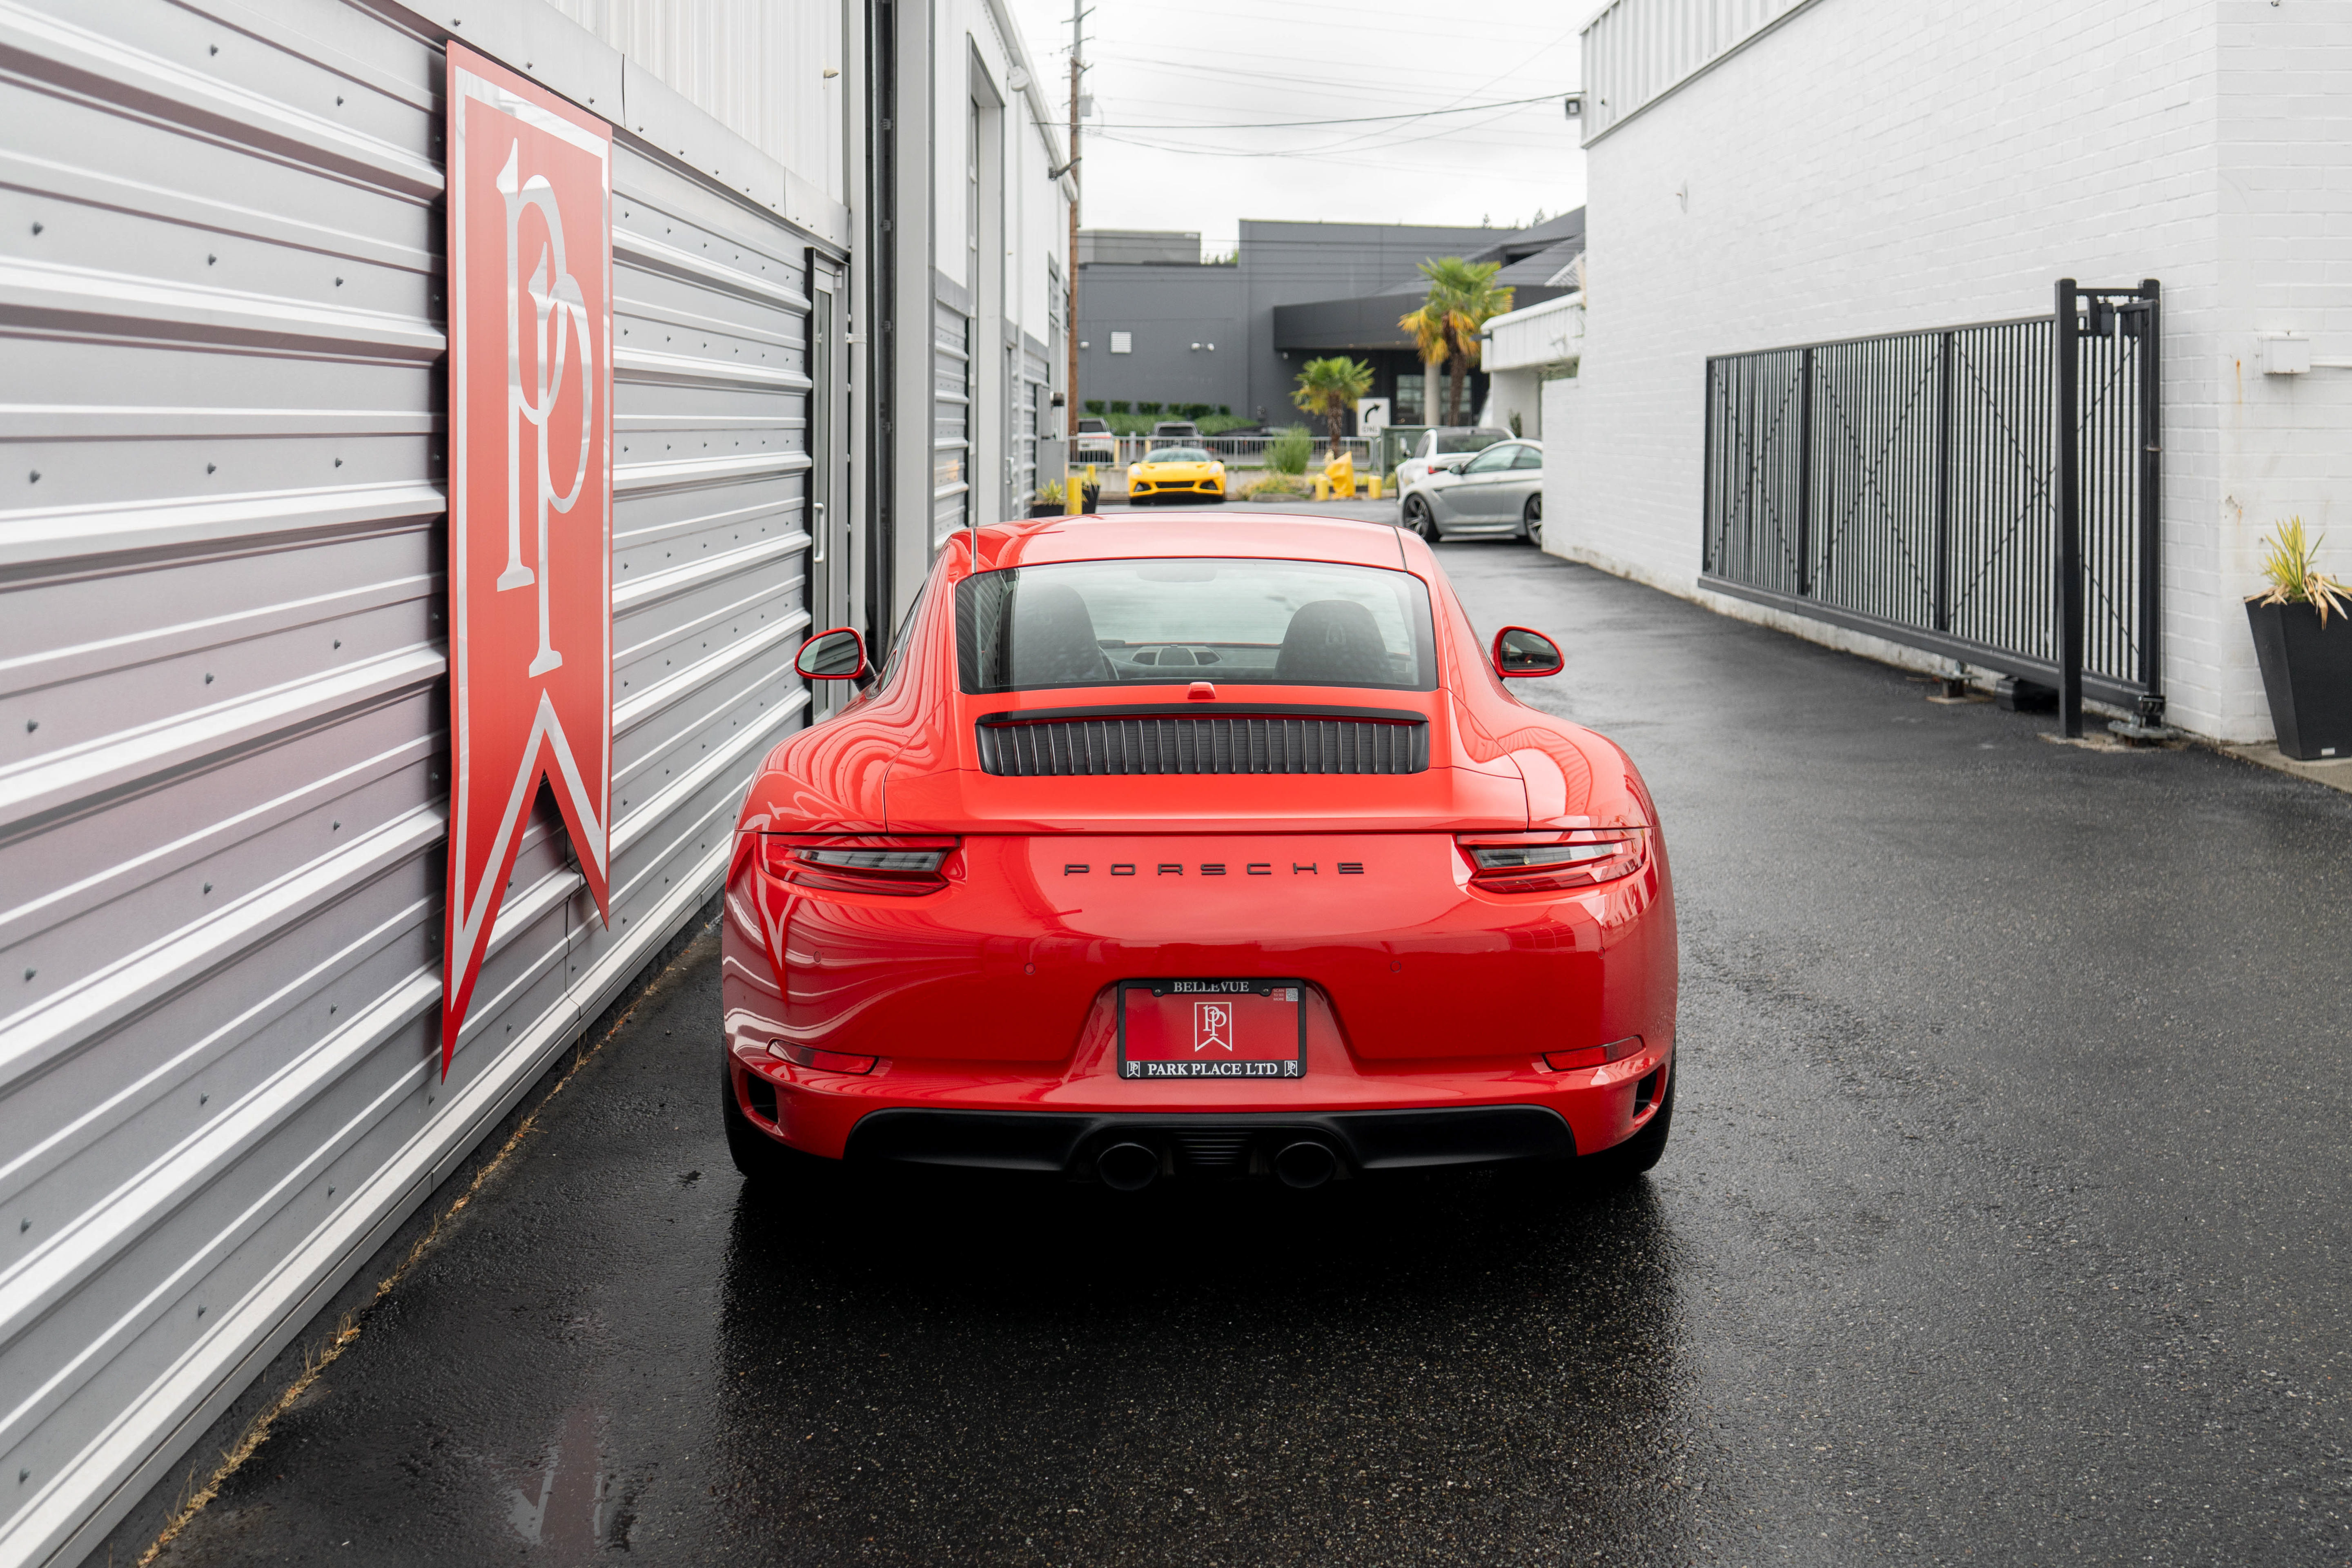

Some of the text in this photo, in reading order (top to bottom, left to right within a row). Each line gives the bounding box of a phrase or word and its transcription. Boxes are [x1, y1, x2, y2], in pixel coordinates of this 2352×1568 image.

[1064, 862, 1364, 876] PORSCHE
[1174, 981, 1249, 992] BELLEVUE
[1147, 1062, 1278, 1075] PARK PLACE LTD
